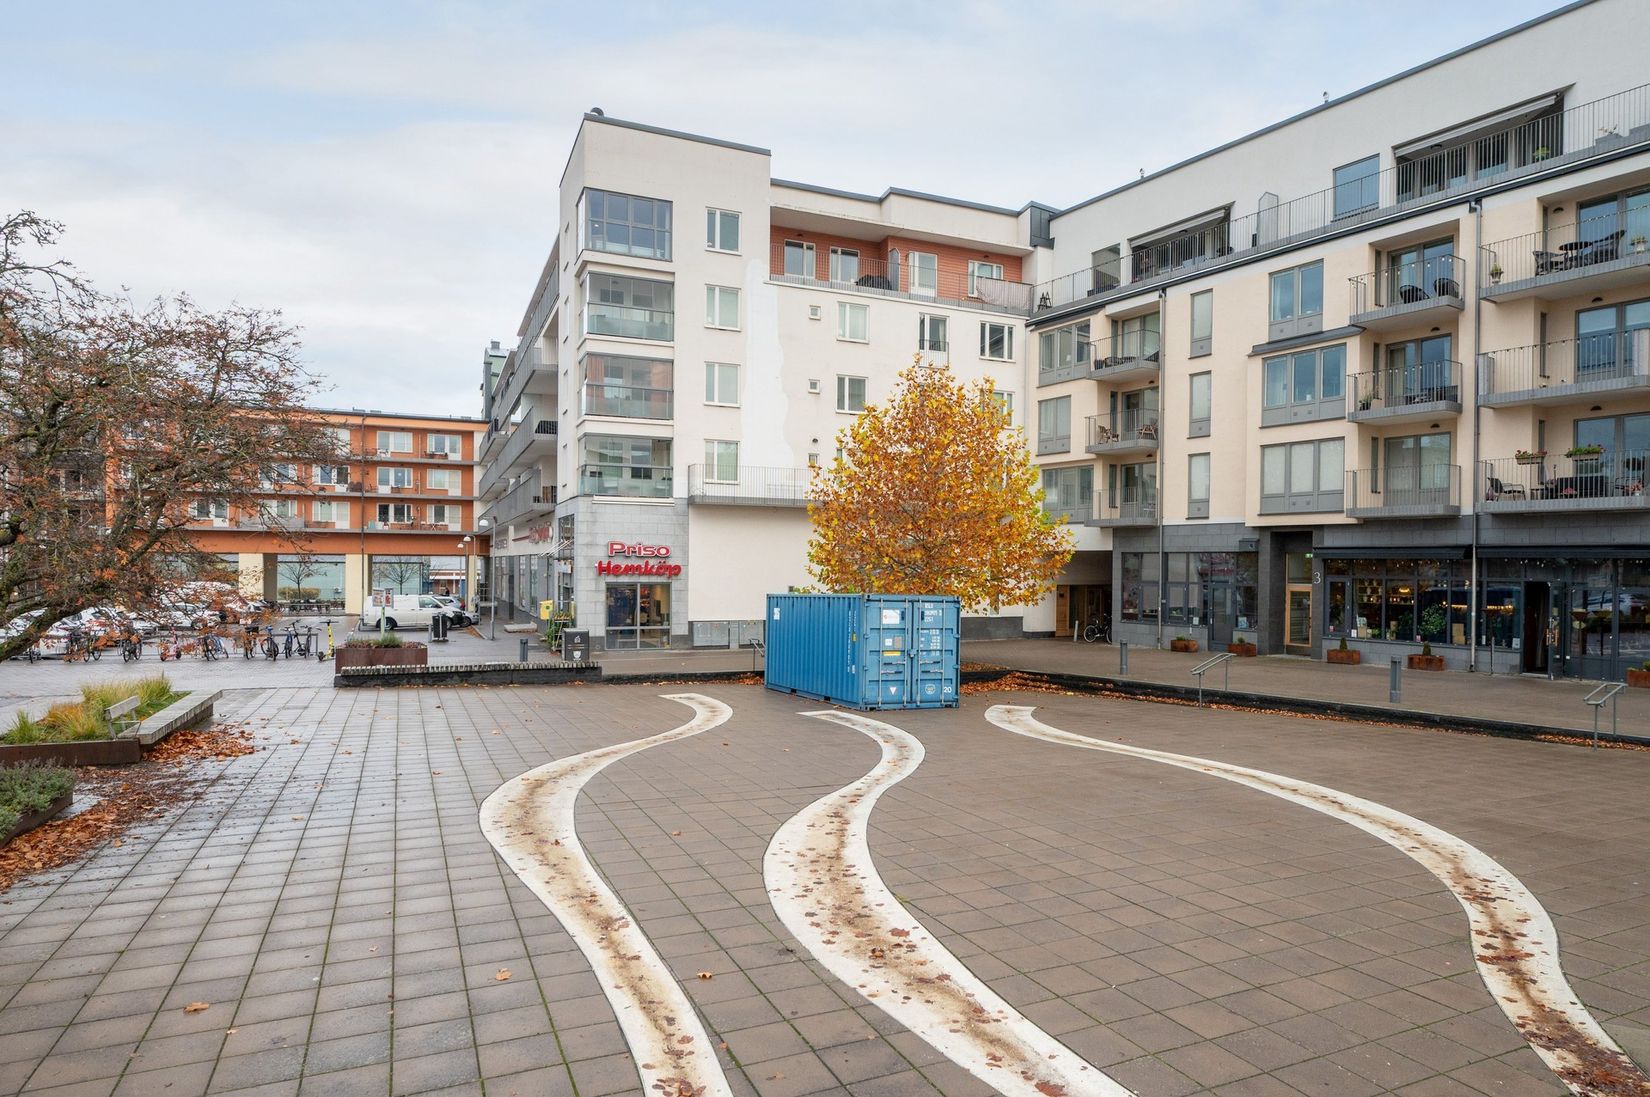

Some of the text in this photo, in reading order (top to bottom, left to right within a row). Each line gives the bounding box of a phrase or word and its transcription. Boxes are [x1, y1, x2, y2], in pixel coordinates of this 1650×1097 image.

[608, 541, 671, 557] Priso
[597, 560, 683, 580] Hemköp
[1313, 571, 1321, 584] 3
